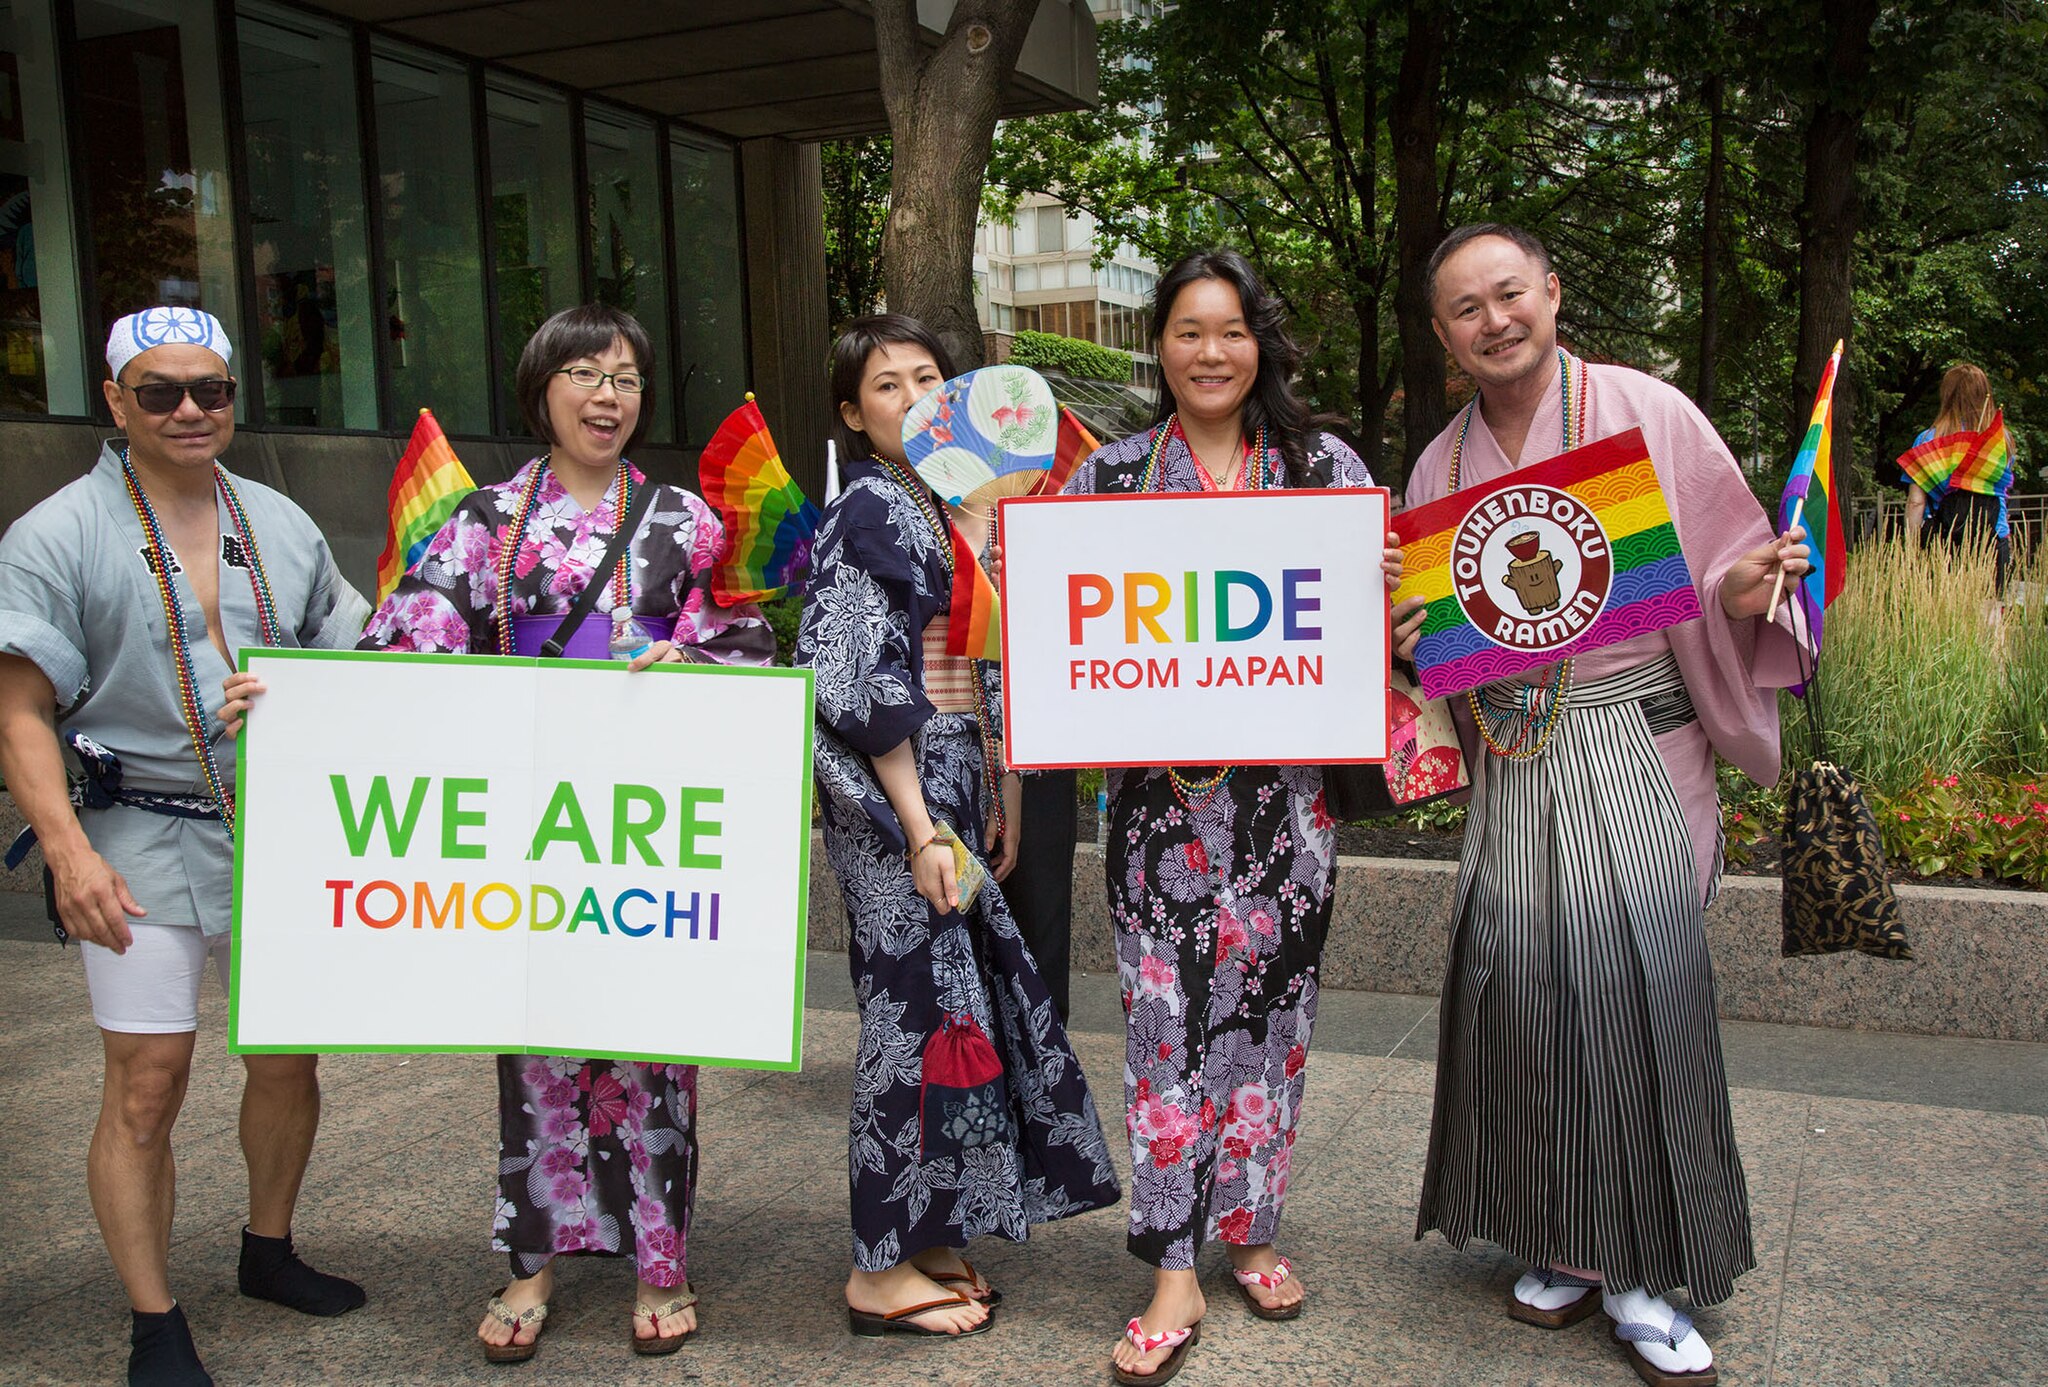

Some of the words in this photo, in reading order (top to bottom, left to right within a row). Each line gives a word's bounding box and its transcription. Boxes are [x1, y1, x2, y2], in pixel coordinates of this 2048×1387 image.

[1456, 491, 1606, 602] TOUHENBOKU
[1067, 569, 1322, 646] PRIDE
[1494, 590, 1600, 645] RAMEN
[1069, 658, 1180, 691] FROM
[1196, 655, 1323, 689] JAPAN
[329, 774, 489, 860] WE
[525, 781, 725, 870] ARE
[325, 879, 721, 941] TOMODACHI
